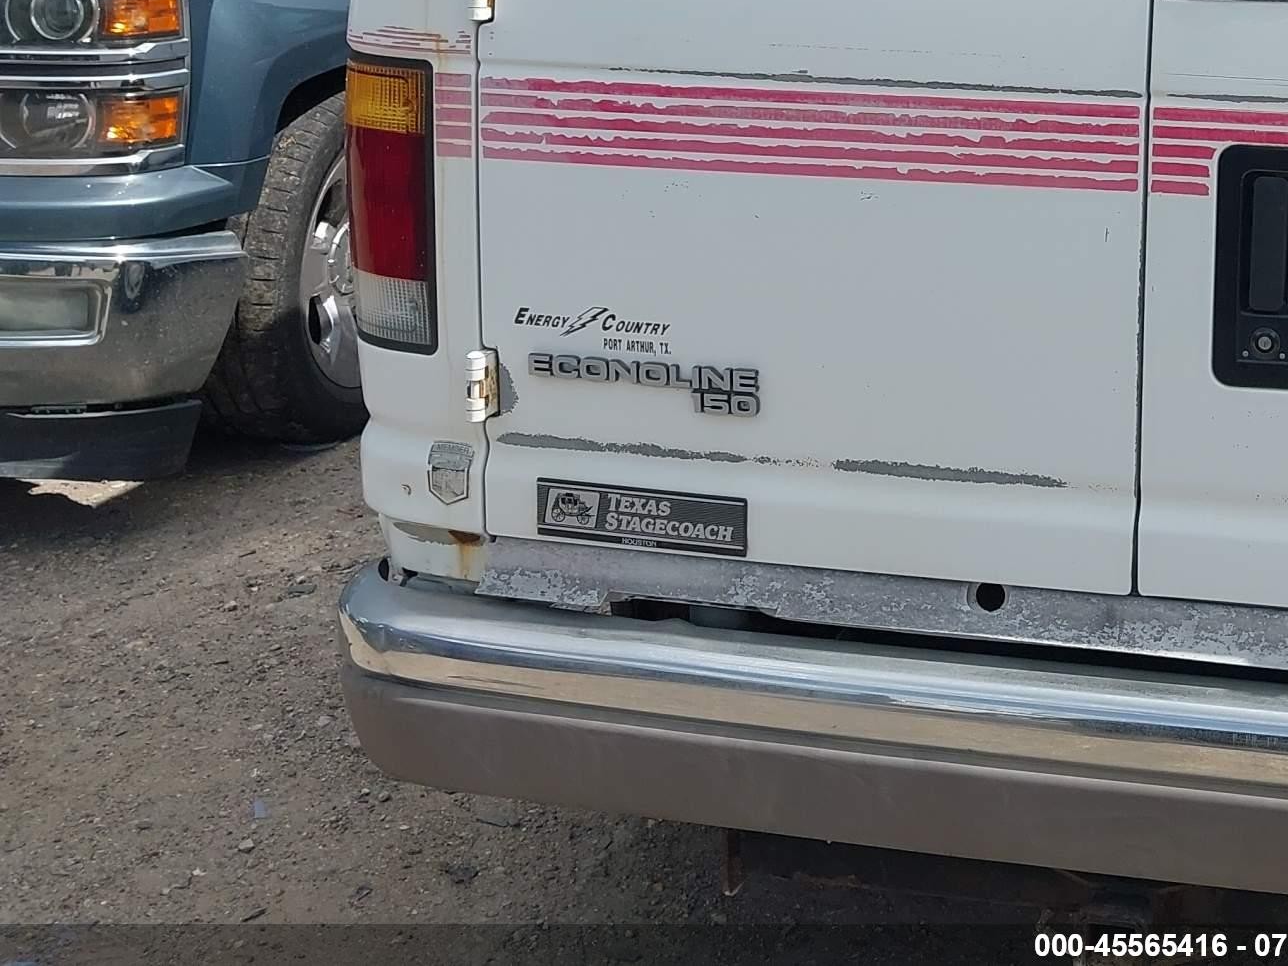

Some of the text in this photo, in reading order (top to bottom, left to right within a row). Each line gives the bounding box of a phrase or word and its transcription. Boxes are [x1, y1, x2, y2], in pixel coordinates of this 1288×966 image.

[603, 338, 672, 356] PORT ARTHUR, TX.
[528, 353, 760, 393] ECONOLINE
[692, 392, 760, 417] 150
[607, 493, 672, 516] TEXAS
[605, 512, 734, 542] STAGECOACH
[622, 537, 657, 547] HOUSTON
